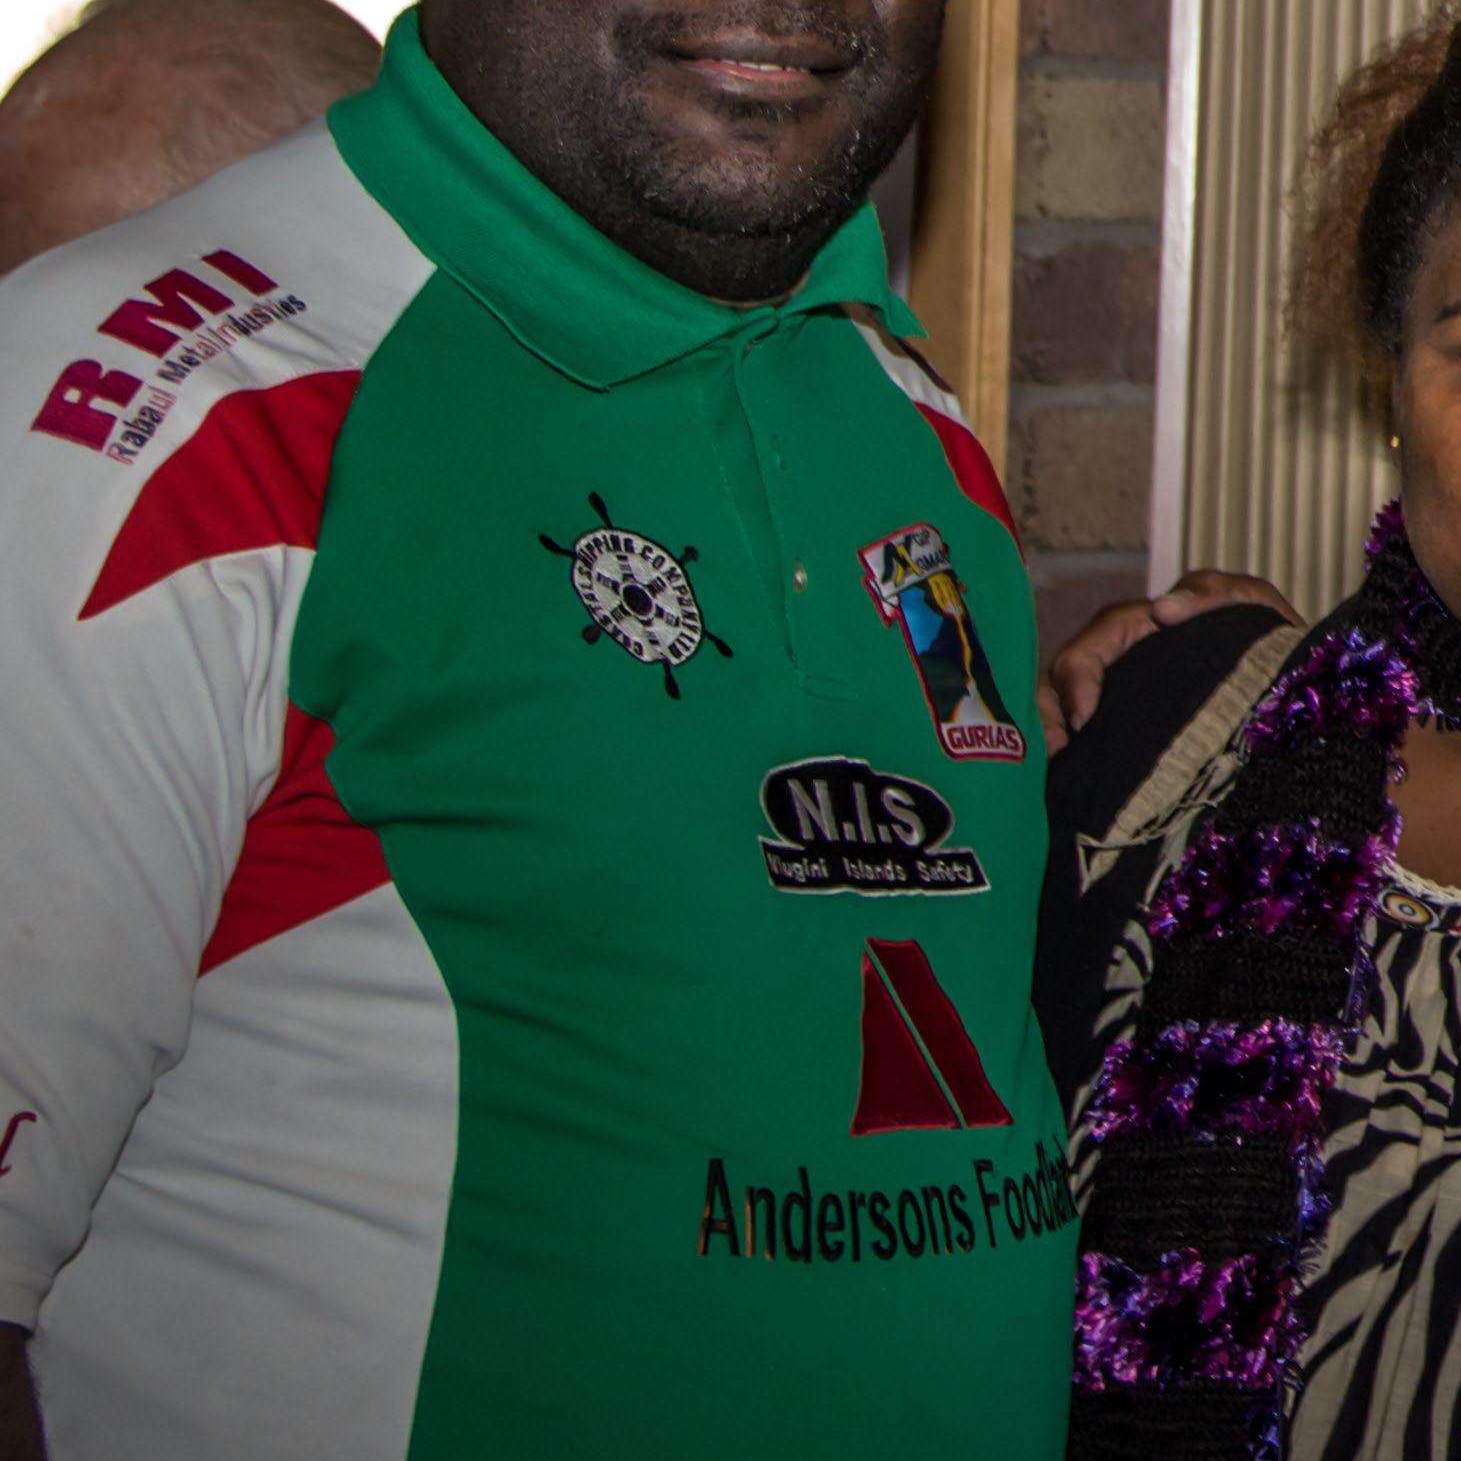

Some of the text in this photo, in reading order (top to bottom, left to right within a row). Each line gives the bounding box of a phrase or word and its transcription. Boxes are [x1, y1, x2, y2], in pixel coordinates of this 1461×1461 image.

[29, 248, 280, 453] RMI
[105, 385, 178, 466] Rabaul
[156, 333, 224, 385] Metal
[946, 724, 1021, 751] GURIAS
[842, 856, 907, 882] Islands
[696, 1157, 977, 1264] Andersons
